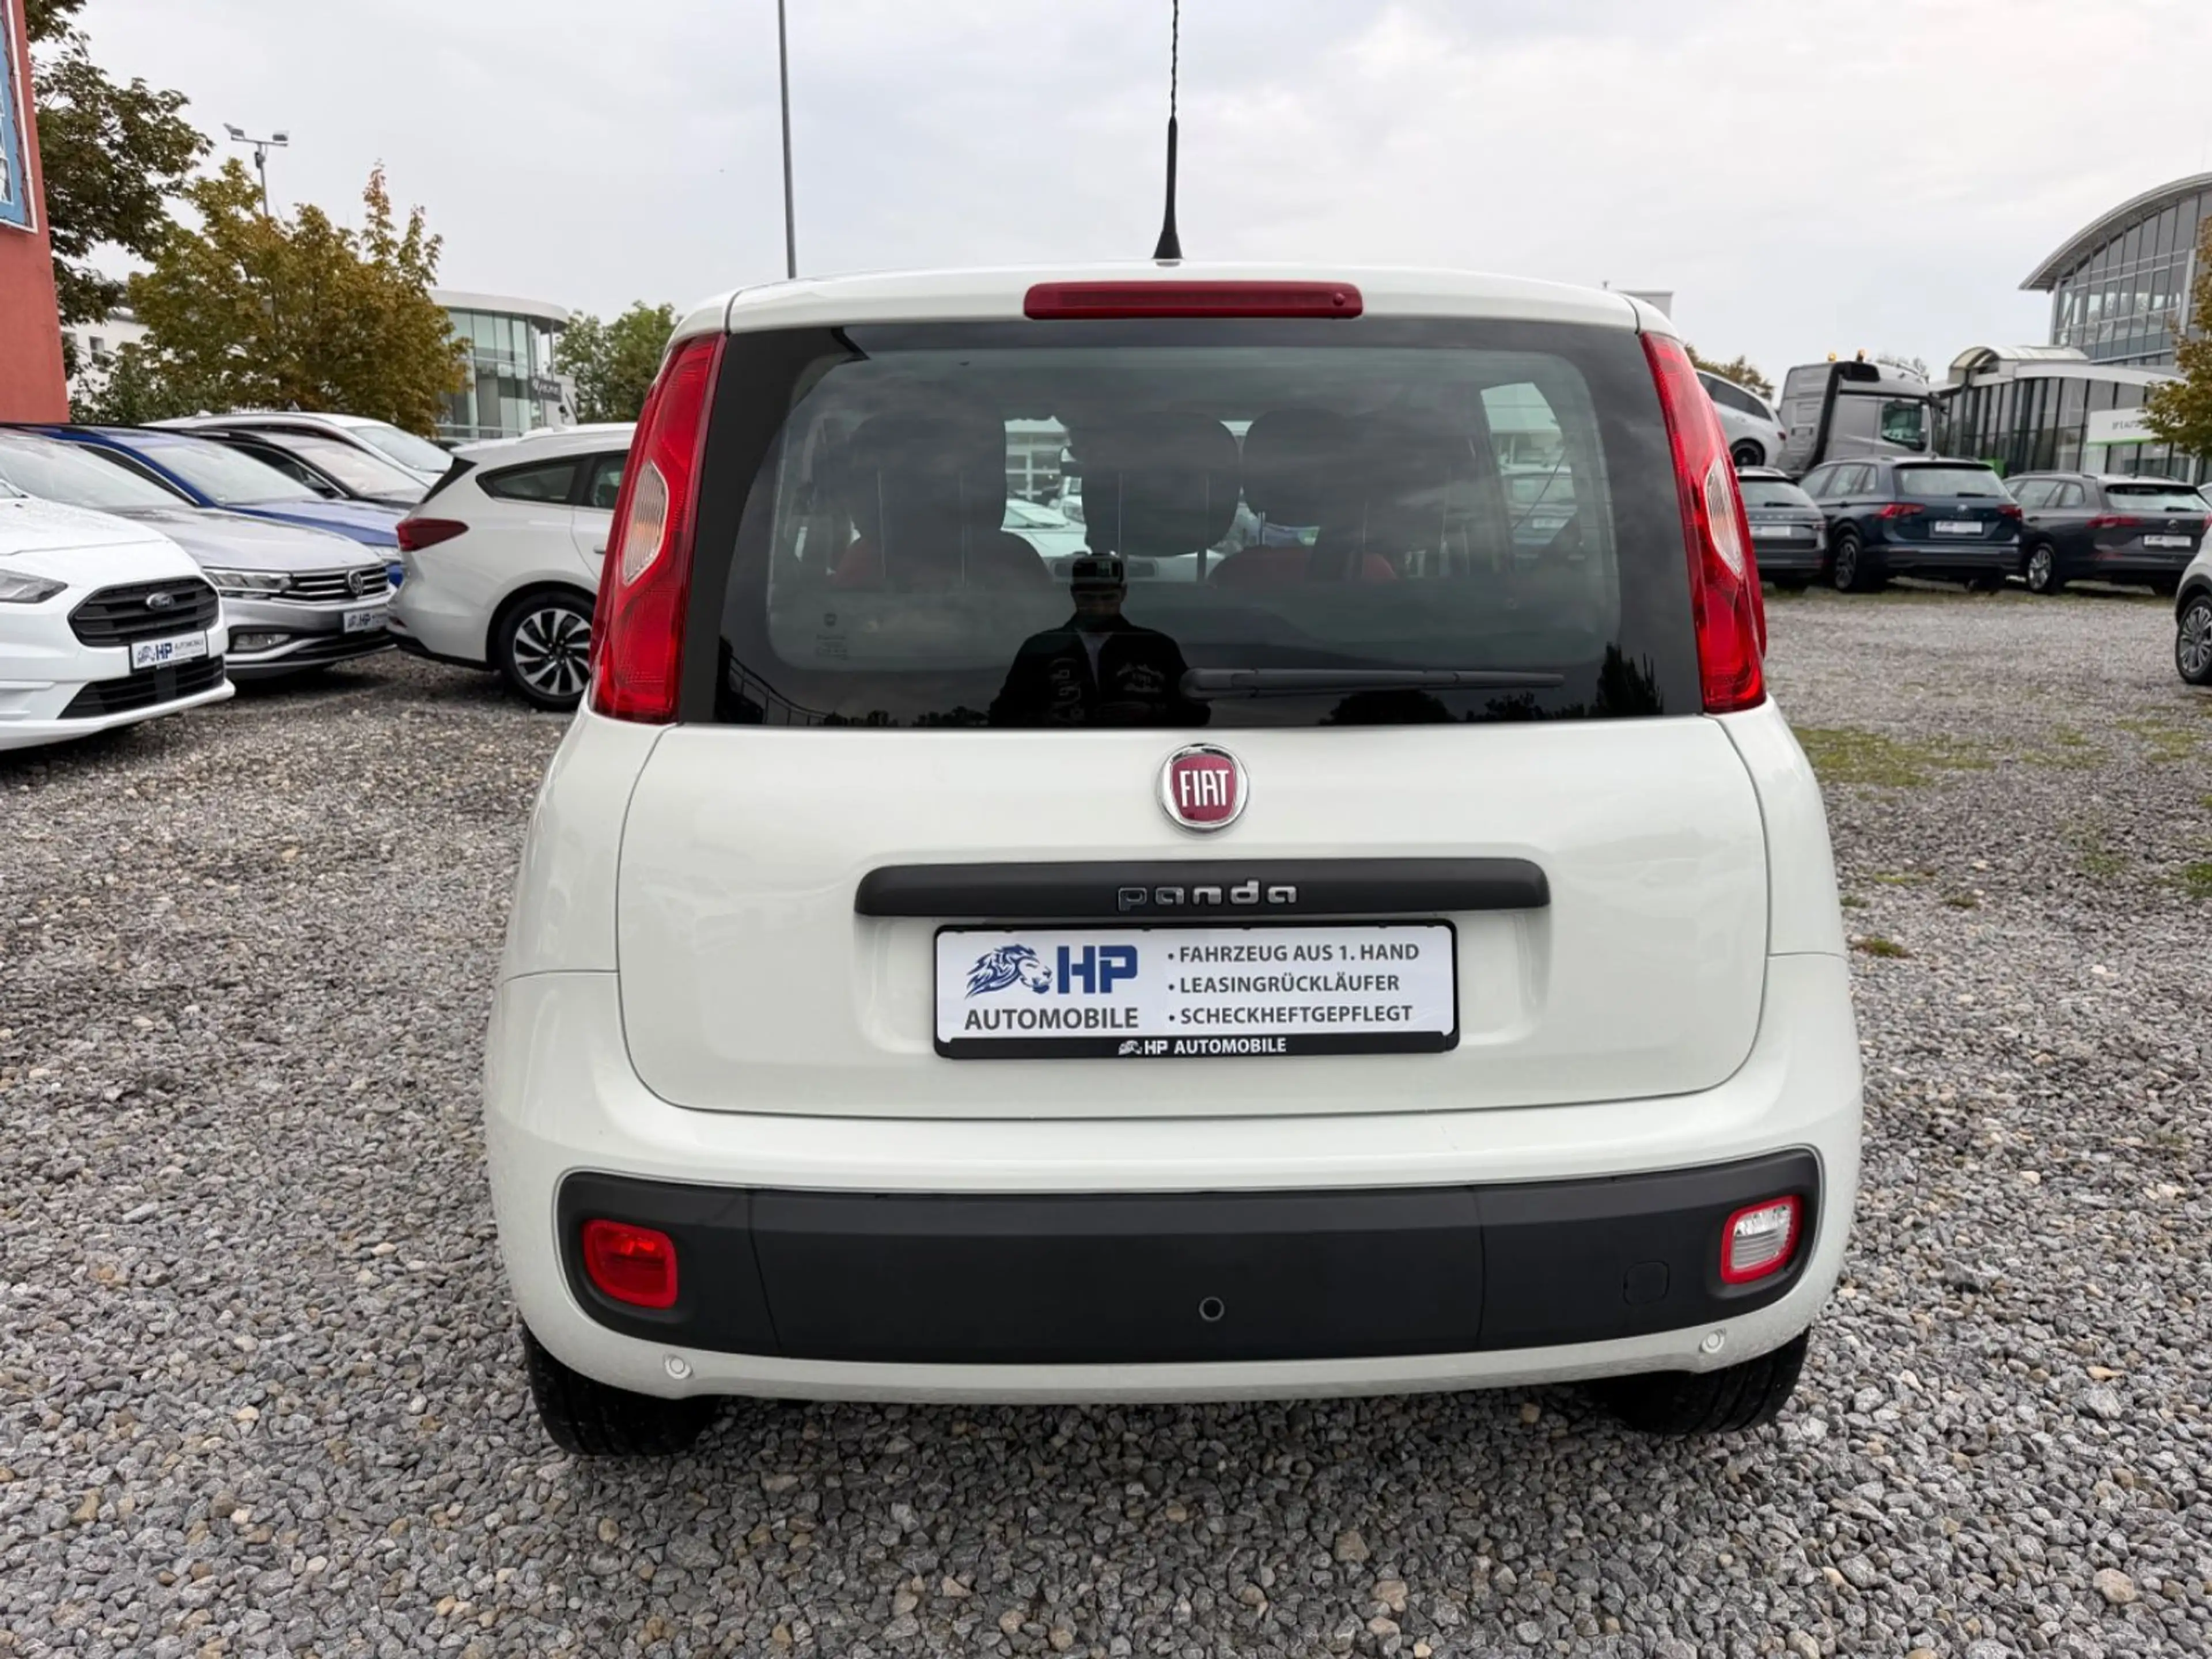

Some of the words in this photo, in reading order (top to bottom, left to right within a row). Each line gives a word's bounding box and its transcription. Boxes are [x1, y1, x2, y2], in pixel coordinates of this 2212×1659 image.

[156, 642, 172, 661] HP
[1179, 769, 1230, 808] FIAT
[1118, 880, 1296, 912] panda
[1180, 945, 1287, 963] FAHRZEUG
[1293, 944, 1333, 961] AUS
[1339, 944, 1355, 961] 1.
[1360, 944, 1419, 961] HAND
[1057, 945, 1138, 994] HP
[1180, 972, 1400, 994] LEASINGRÜCKLÄUFER
[964, 1007, 1138, 1031] AUTOMOBILE
[1180, 1005, 1414, 1024] SCHECKHEFTGEPFLEGT
[1144, 1040, 1169, 1055] HP
[1173, 1037, 1287, 1055] AUTOMOBILE
